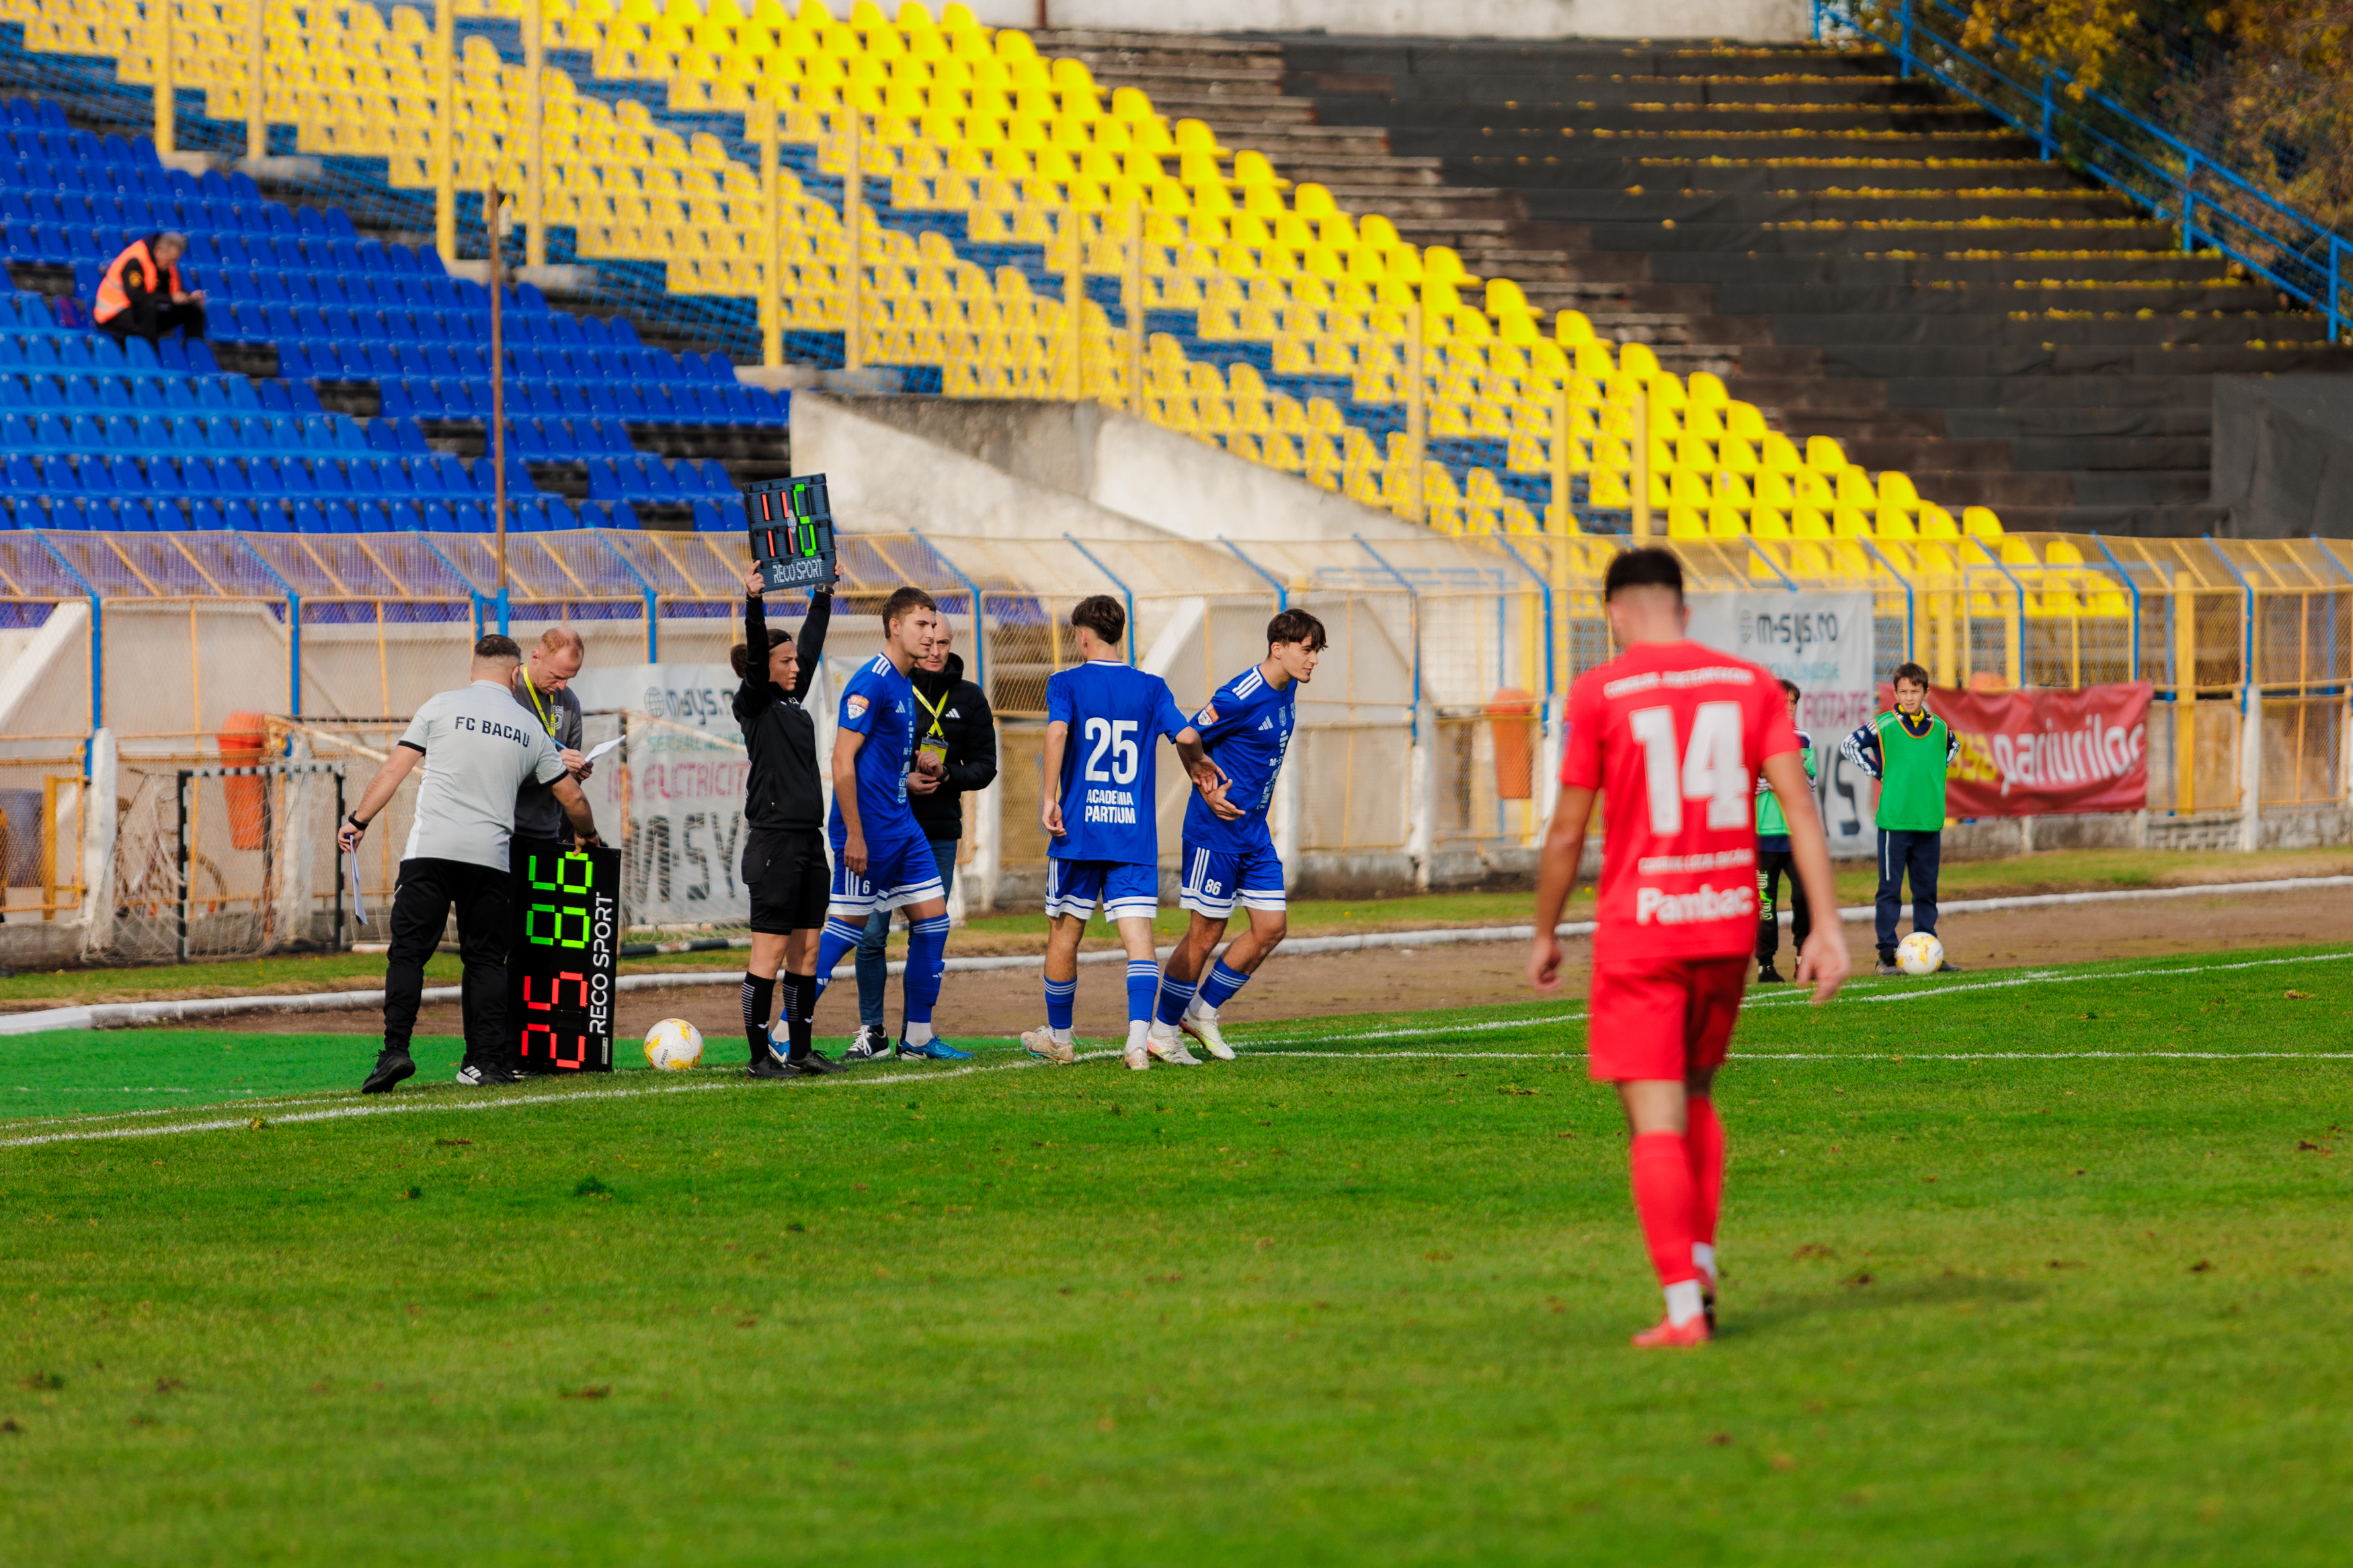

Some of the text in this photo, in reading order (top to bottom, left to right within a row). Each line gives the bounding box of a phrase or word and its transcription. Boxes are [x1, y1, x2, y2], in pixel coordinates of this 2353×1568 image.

[772, 559, 824, 583] RECO SPORT
[454, 716, 475, 731] FC
[481, 720, 530, 747] BACAU
[1084, 717, 1138, 784] 25
[1628, 700, 1751, 838] 14
[1946, 730, 1997, 782] asa
[1084, 805, 1136, 824] PARTIUM
[1086, 789, 1134, 806] ACADEMIA
[621, 809, 752, 905] M-SY
[863, 880, 870, 895] 6
[1205, 878, 1222, 895] 86
[1636, 883, 1755, 925] Pambac
[521, 852, 593, 1069] 25 86
[589, 891, 613, 1035] RECO SPORT
